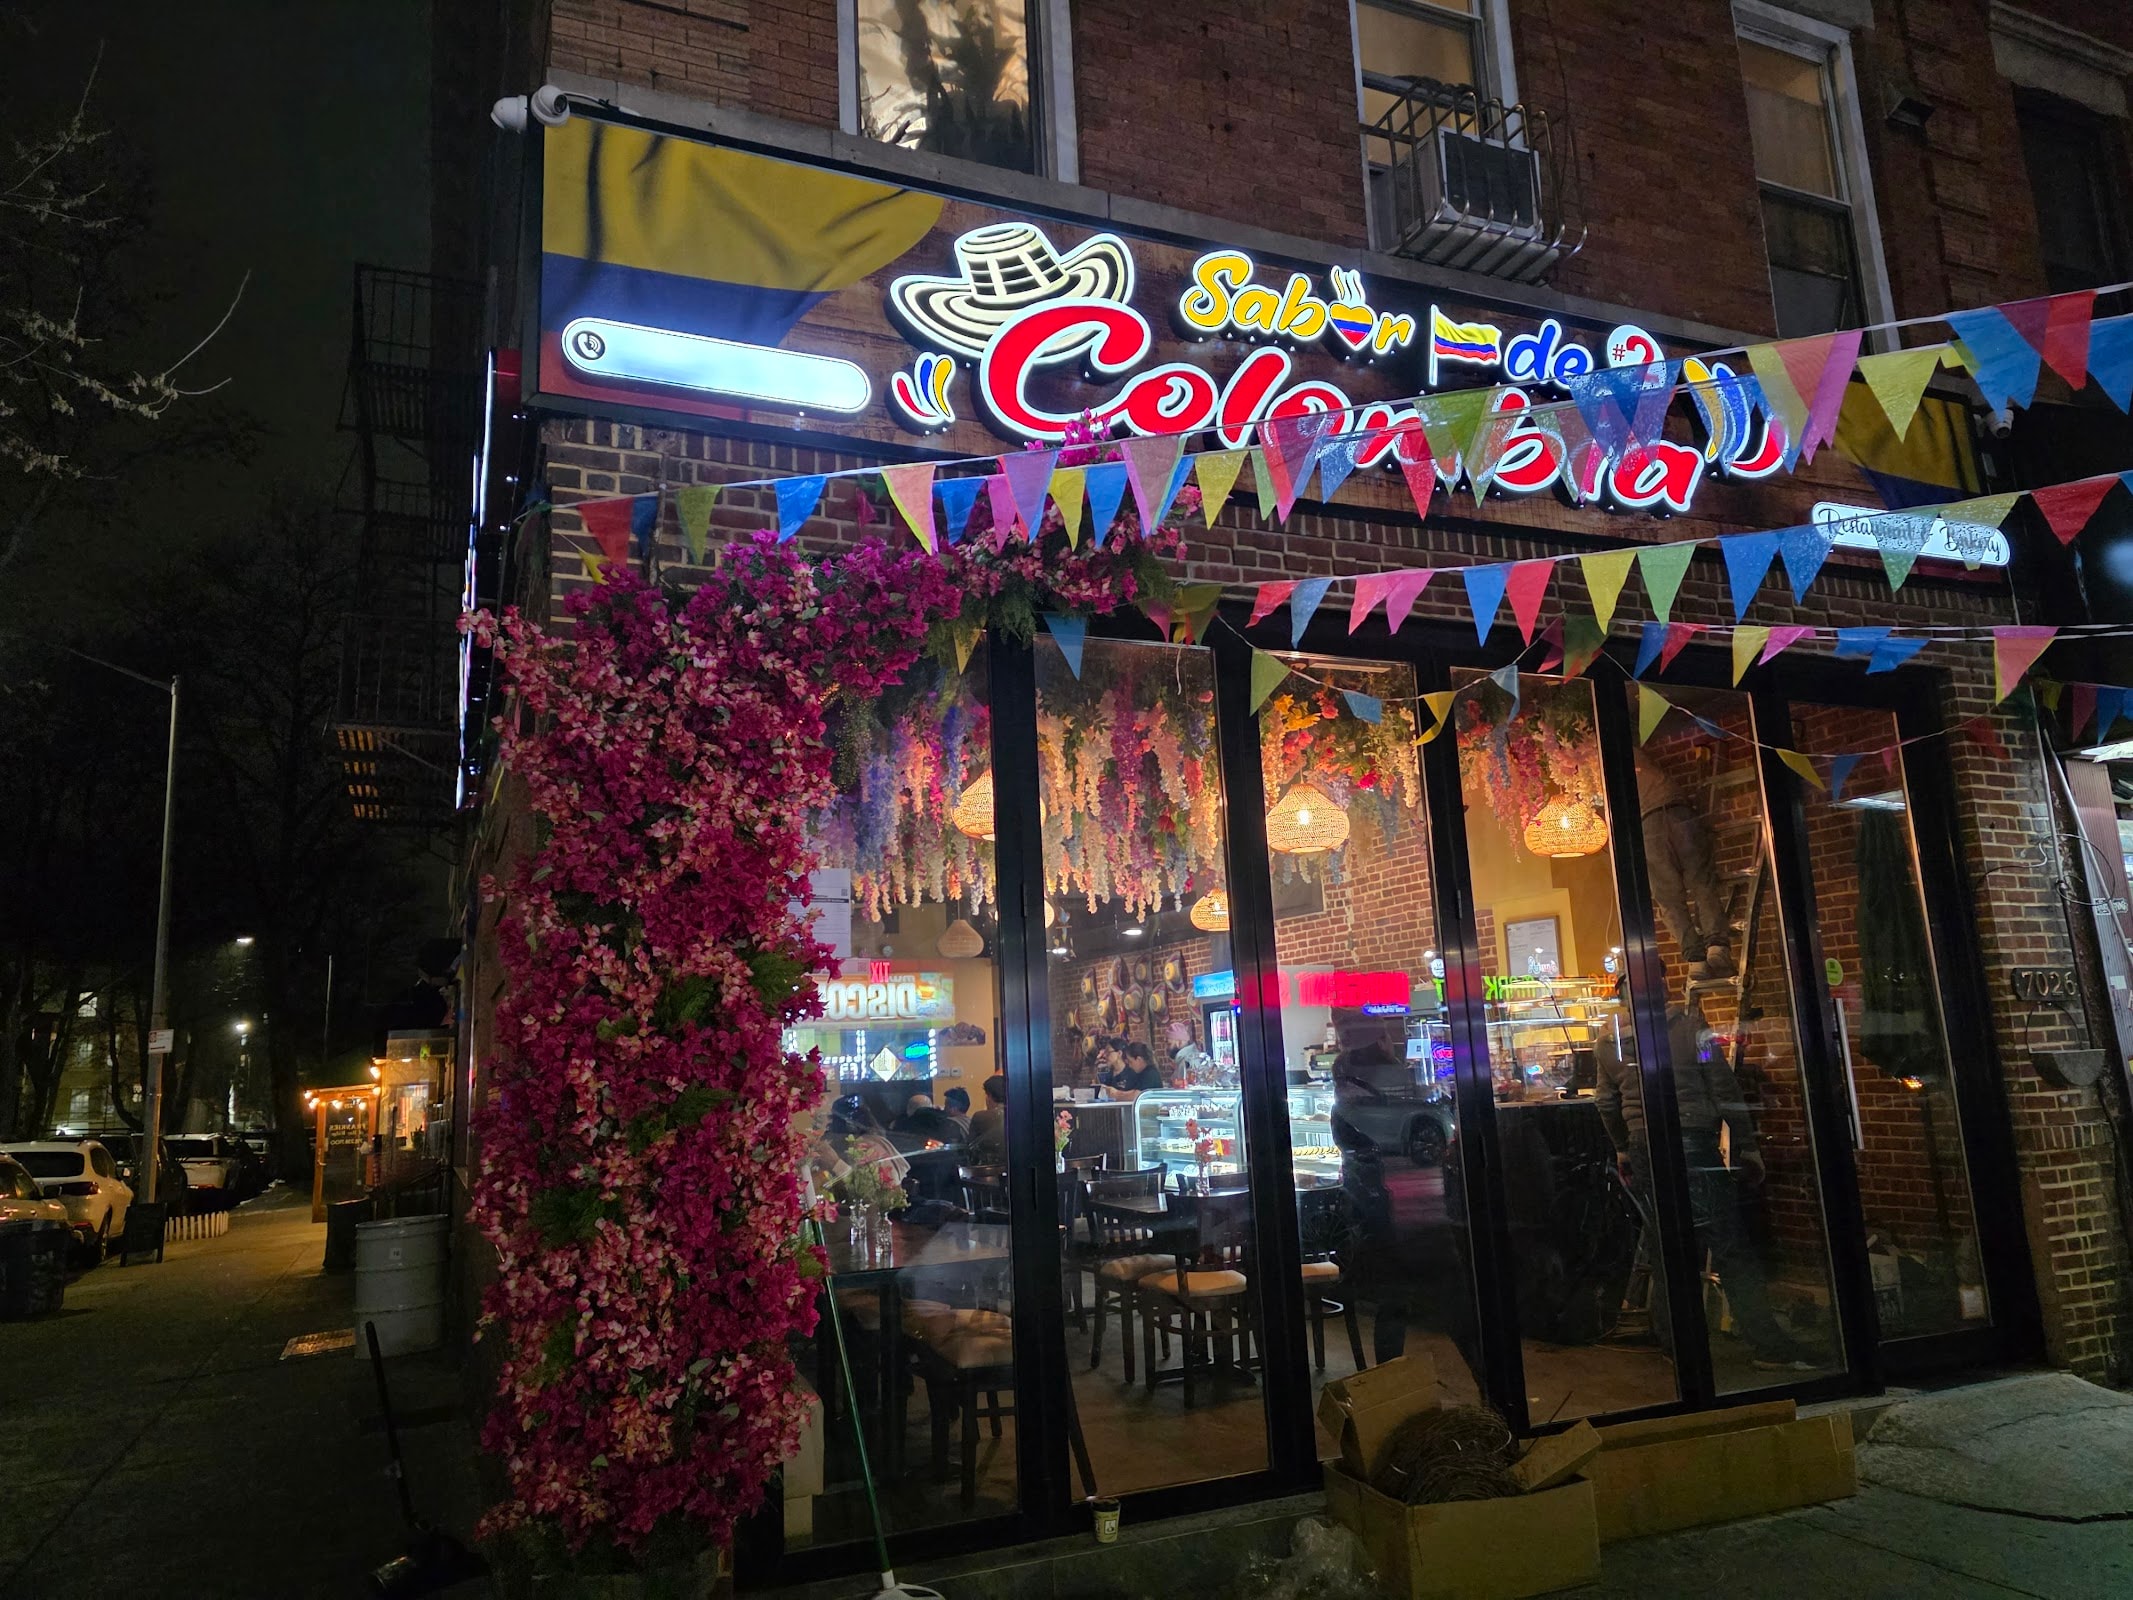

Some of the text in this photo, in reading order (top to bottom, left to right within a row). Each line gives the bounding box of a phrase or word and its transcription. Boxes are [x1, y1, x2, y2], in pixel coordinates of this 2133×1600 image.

[1505, 319, 1594, 386] de
[981, 298, 1704, 511] Colombia
[2021, 971, 2077, 996] 7026
